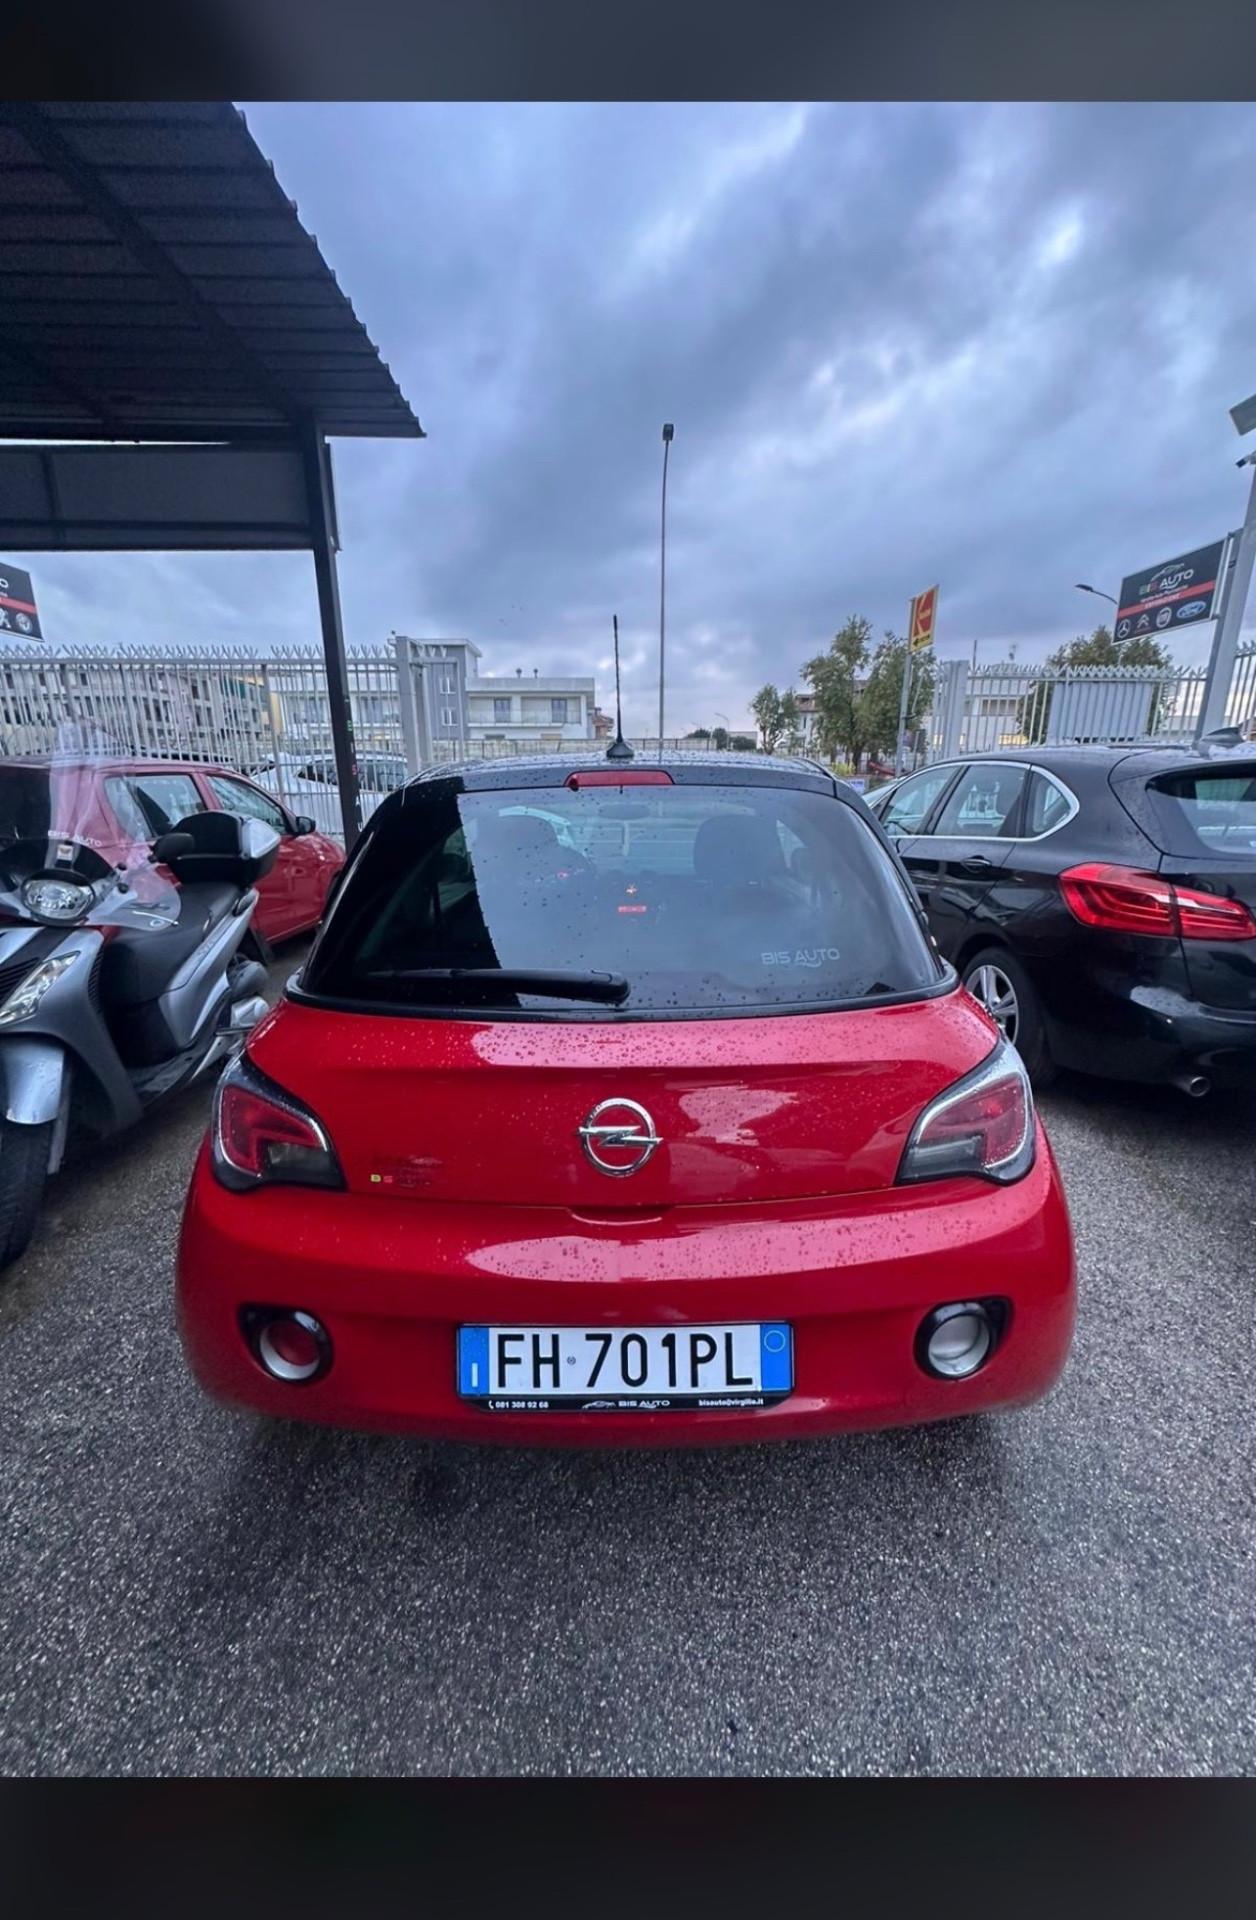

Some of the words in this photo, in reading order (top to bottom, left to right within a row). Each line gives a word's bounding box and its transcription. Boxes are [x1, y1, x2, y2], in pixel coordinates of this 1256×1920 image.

[1160, 569, 1194, 589] AUTO
[761, 952, 792, 965] BIS
[794, 948, 840, 968] AUTO
[498, 1334, 560, 1388] FH
[585, 1333, 753, 1388] 701PL
[638, 1400, 671, 1409] AUTO
